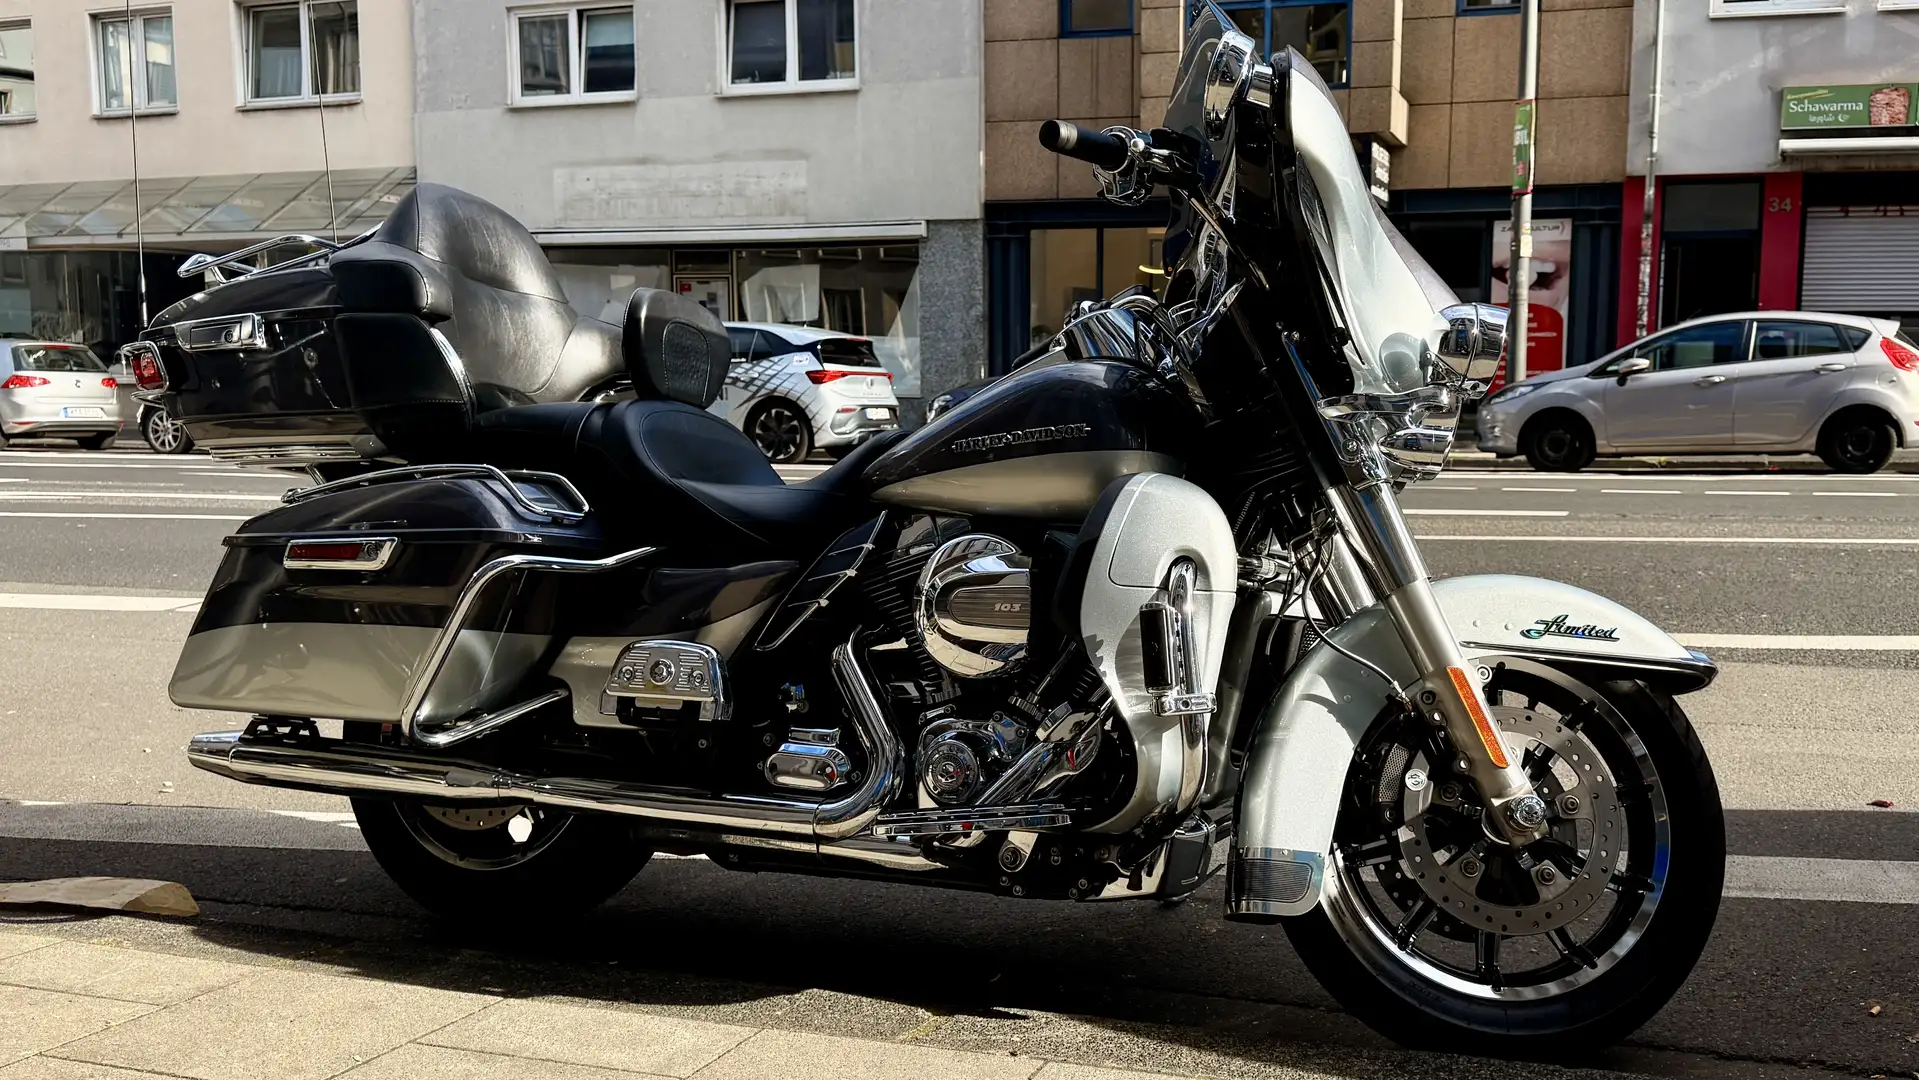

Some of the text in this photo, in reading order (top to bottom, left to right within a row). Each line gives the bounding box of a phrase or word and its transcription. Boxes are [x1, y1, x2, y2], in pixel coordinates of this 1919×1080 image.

[1789, 99, 1864, 112] Schawarma
[1768, 197, 1793, 213] 34
[993, 602, 1022, 612] 103
[1519, 614, 1621, 642] Limited
